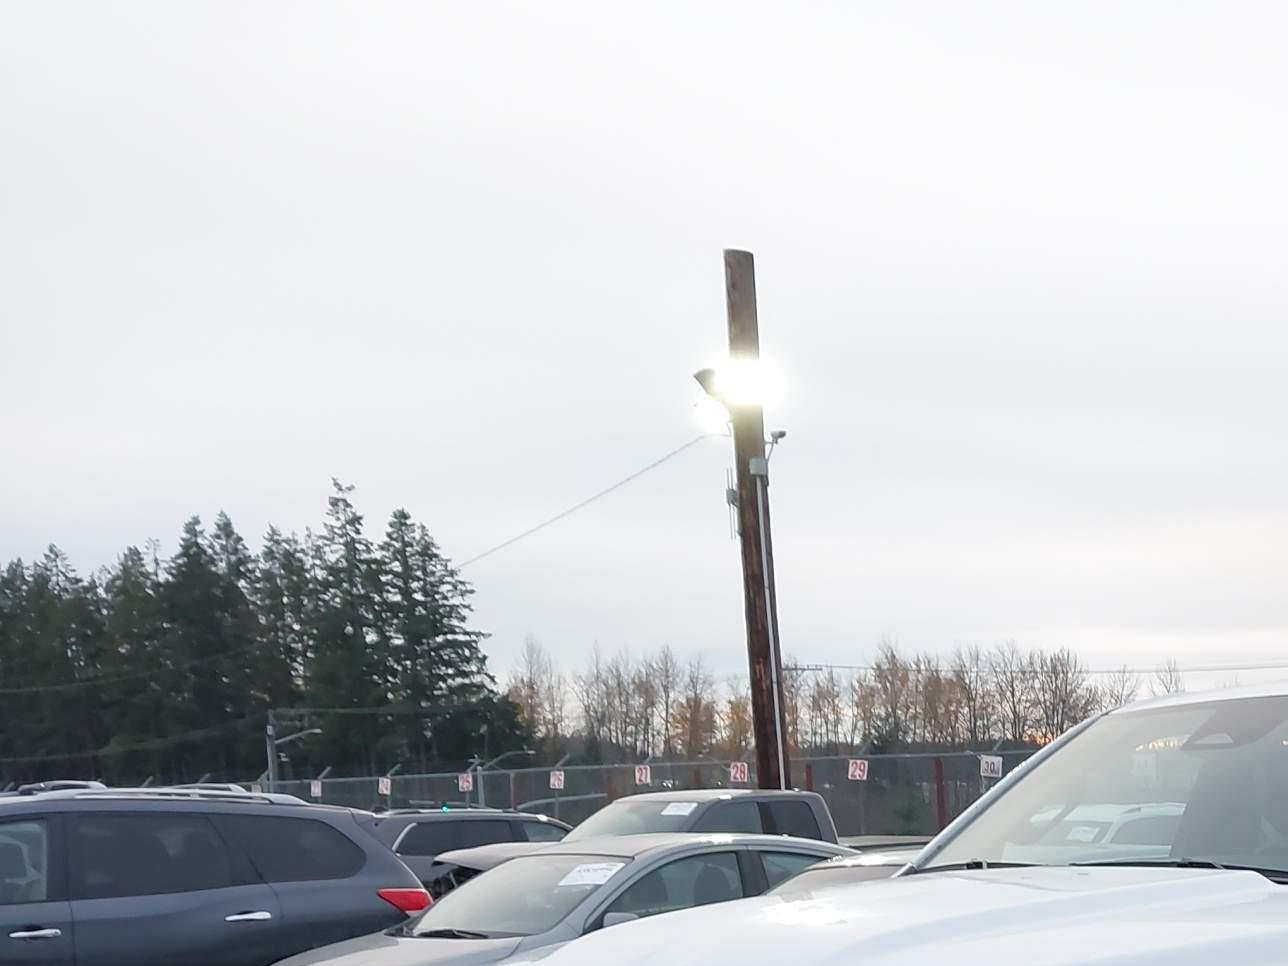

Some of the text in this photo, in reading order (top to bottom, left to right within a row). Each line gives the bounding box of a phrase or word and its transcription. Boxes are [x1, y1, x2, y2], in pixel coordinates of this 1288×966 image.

[637, 766, 648, 782] 27
[732, 763, 746, 780] 28
[850, 760, 866, 778] 29
